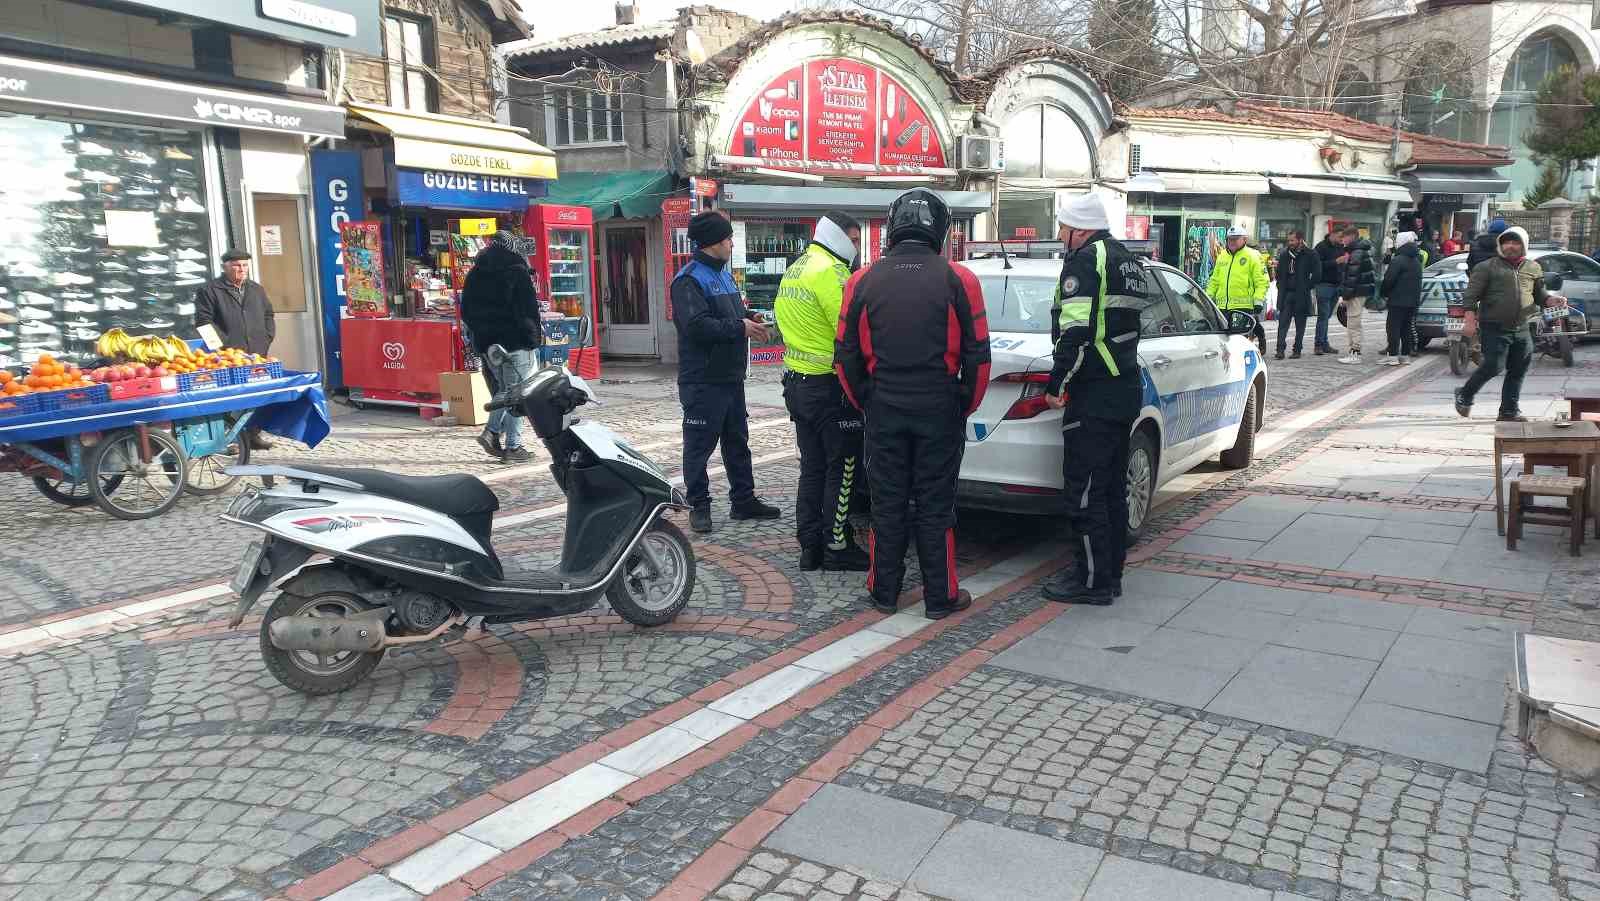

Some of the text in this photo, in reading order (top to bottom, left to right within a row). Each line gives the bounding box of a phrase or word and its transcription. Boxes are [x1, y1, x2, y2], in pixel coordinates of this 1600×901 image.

[0, 76, 27, 92] por
[826, 65, 867, 90] STAR
[274, 115, 302, 127] spor
[769, 147, 799, 159] iPhone
[484, 156, 512, 171] TEKEL
[481, 175, 529, 195] TEKEL
[751, 351, 777, 361] ANDA
